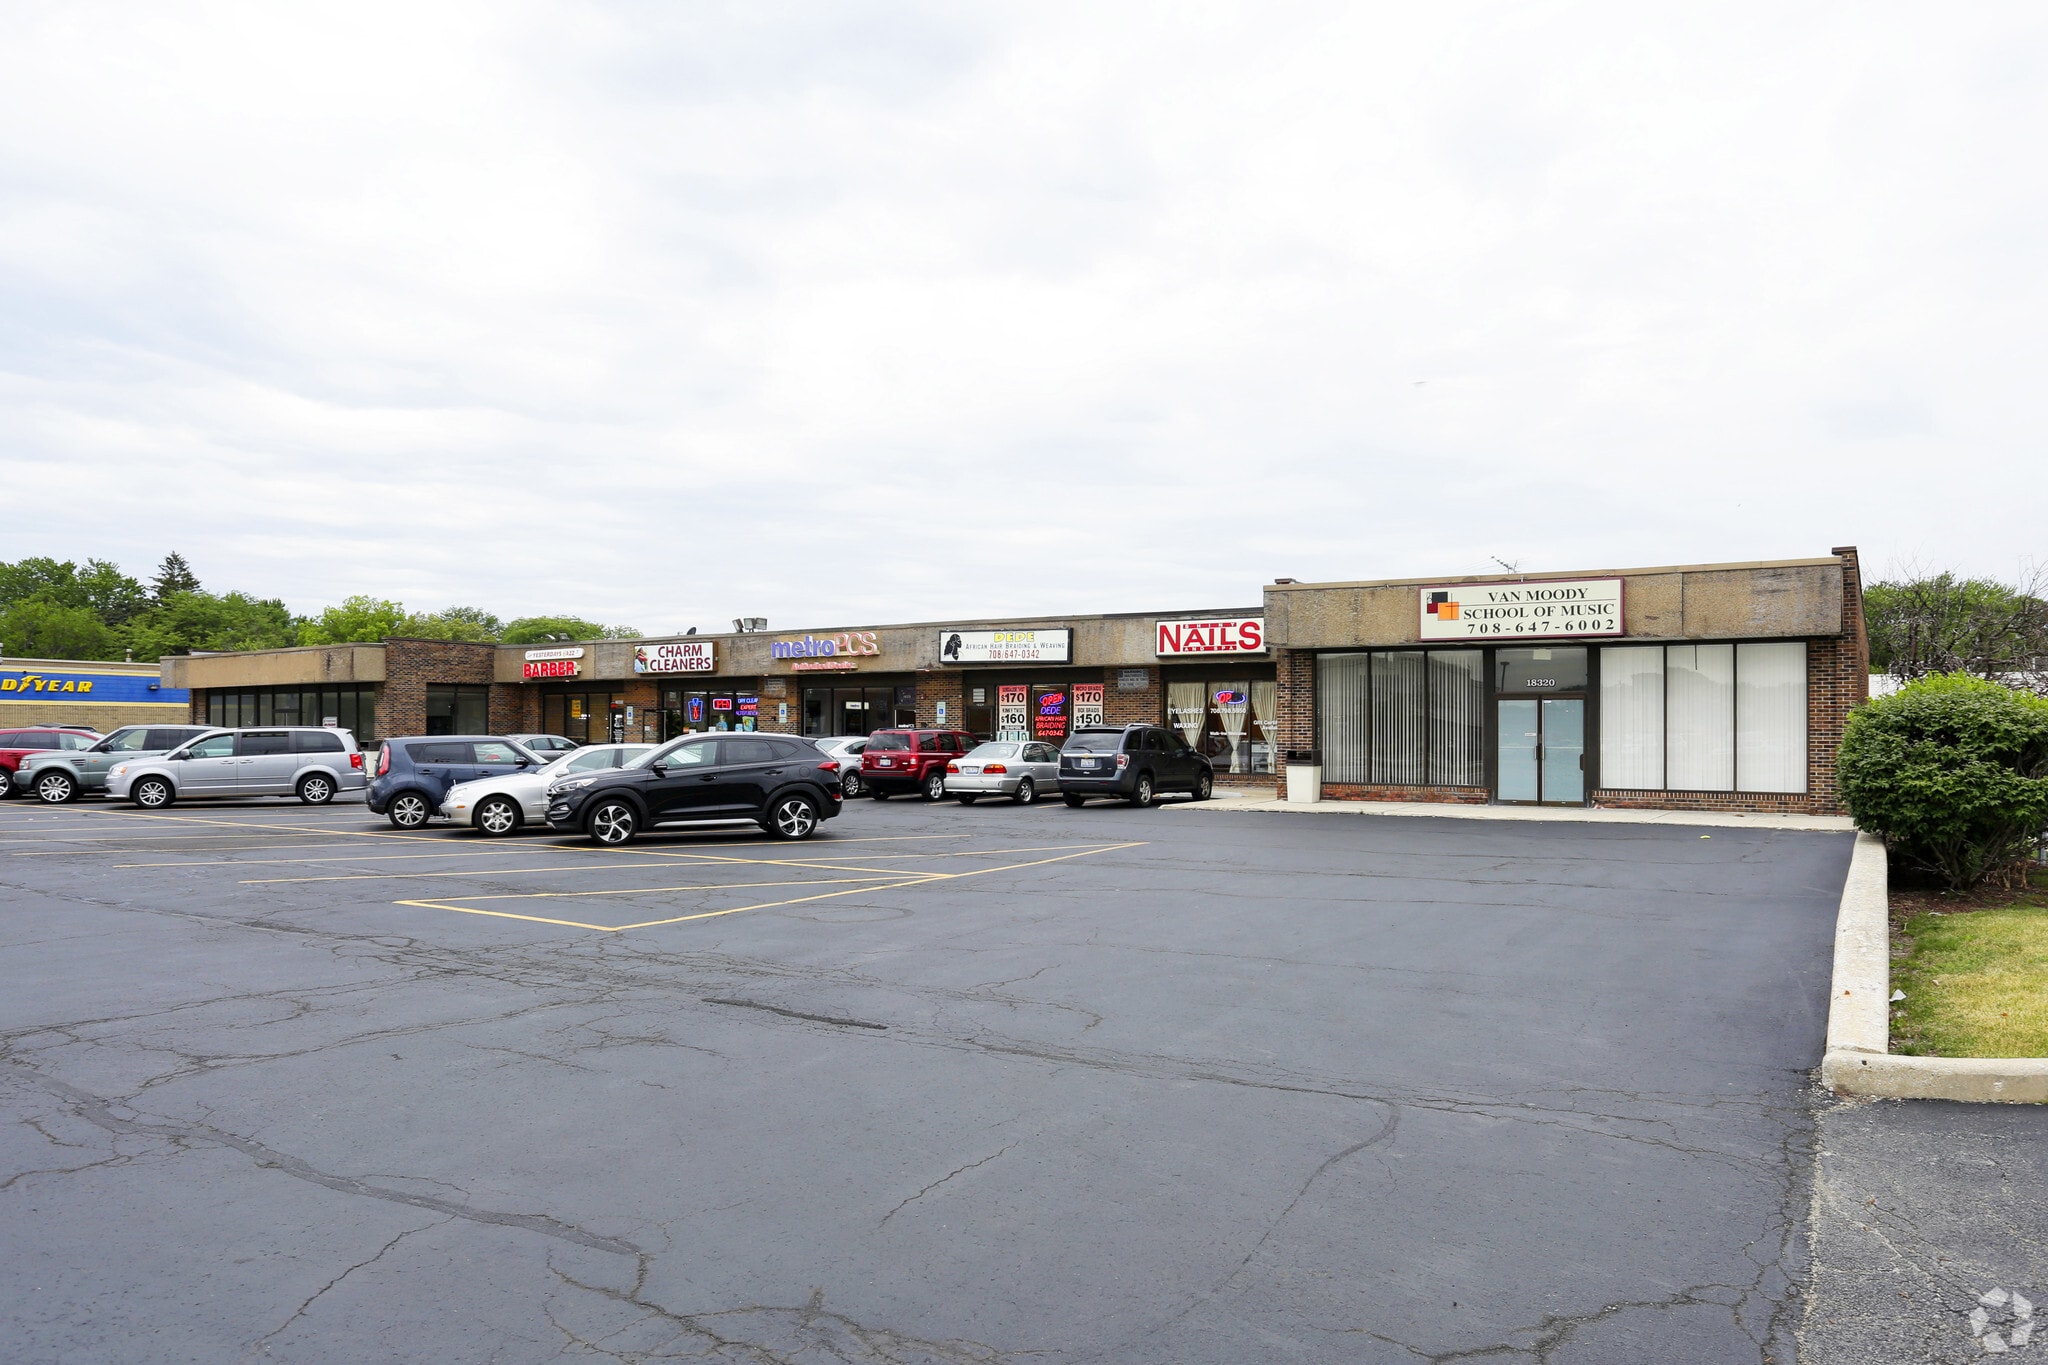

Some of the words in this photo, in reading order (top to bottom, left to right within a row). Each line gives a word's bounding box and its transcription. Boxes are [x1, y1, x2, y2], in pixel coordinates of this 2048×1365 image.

[1488, 591, 1521, 603] VAN
[1525, 588, 1588, 601] MOODY
[1463, 606, 1529, 620] SCHOOL
[1534, 606, 1556, 617] OF
[1561, 603, 1615, 616] MUSIC
[1467, 619, 1615, 634] 708-647-6002
[994, 632, 1035, 643] DEDE
[1159, 621, 1262, 652] NAILS
[657, 644, 702, 658] CHARM
[771, 632, 877, 657] metroPCS
[989, 650, 1040, 659] 708/647-0342
[523, 661, 575, 678] BARBER
[650, 657, 711, 671] CLEANERS
[1526, 679, 1556, 687] 18320
[1001, 692, 1025, 703] $170
[1041, 692, 1063, 706] OPEN
[1075, 692, 1101, 702] $170
[1040, 706, 1061, 715] DEDE
[1001, 713, 1025, 724] $160
[1075, 713, 1101, 724] $150
